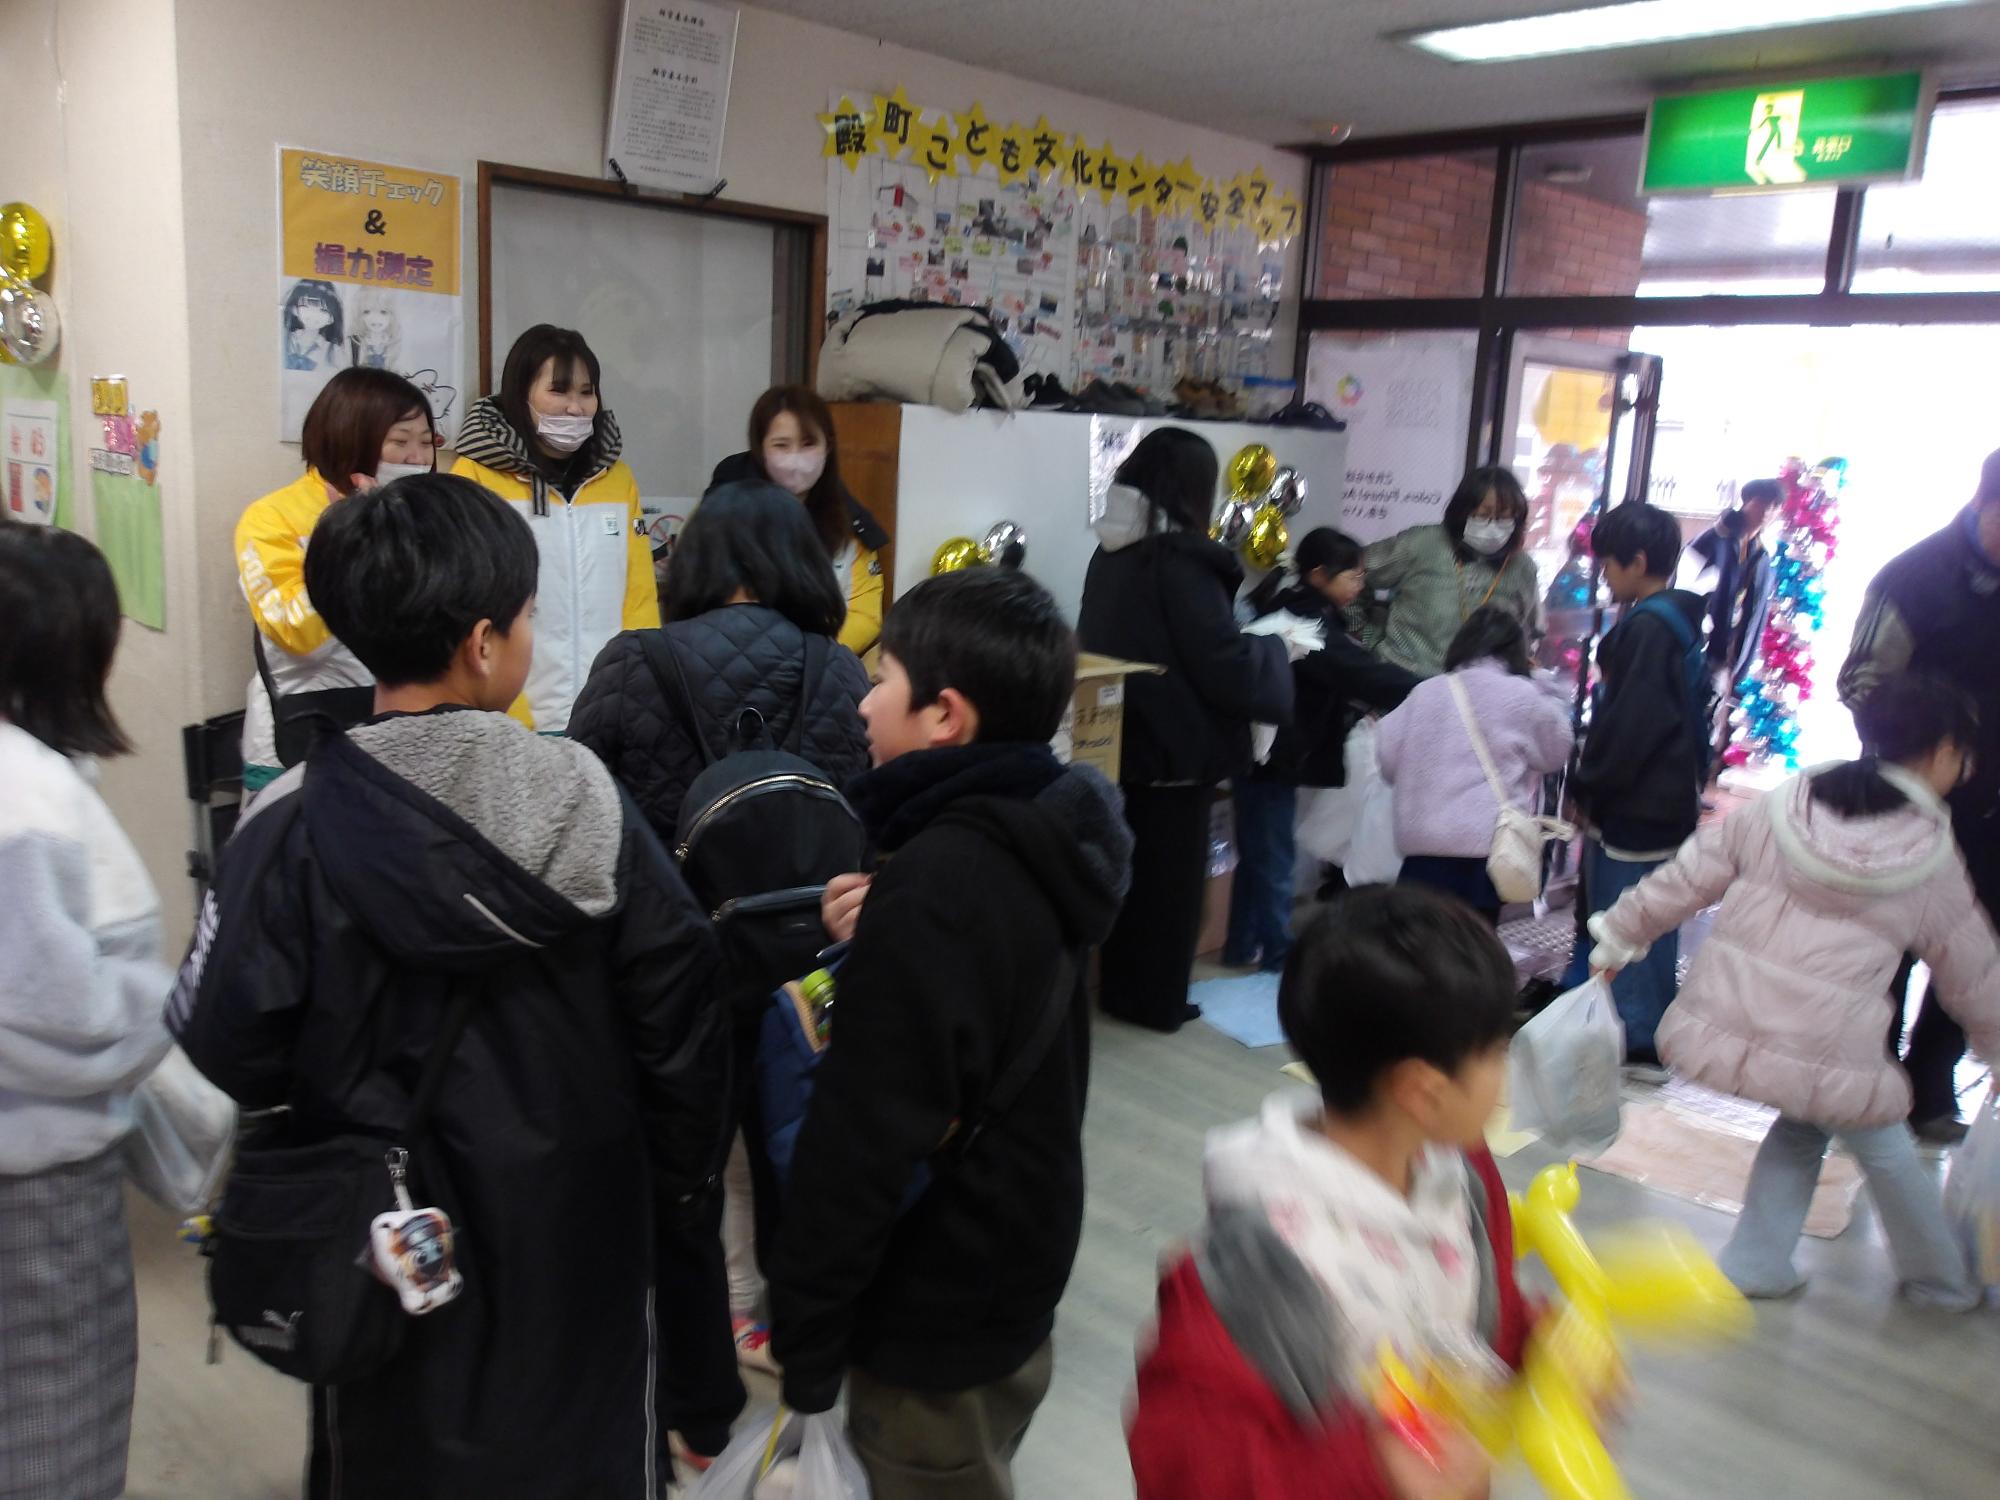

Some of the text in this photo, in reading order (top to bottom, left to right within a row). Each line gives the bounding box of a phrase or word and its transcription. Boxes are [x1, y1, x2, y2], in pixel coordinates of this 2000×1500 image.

[301, 157, 444, 207] 笑顔チェック
[364, 208, 387, 236] &
[313, 241, 435, 288] 握力測定
